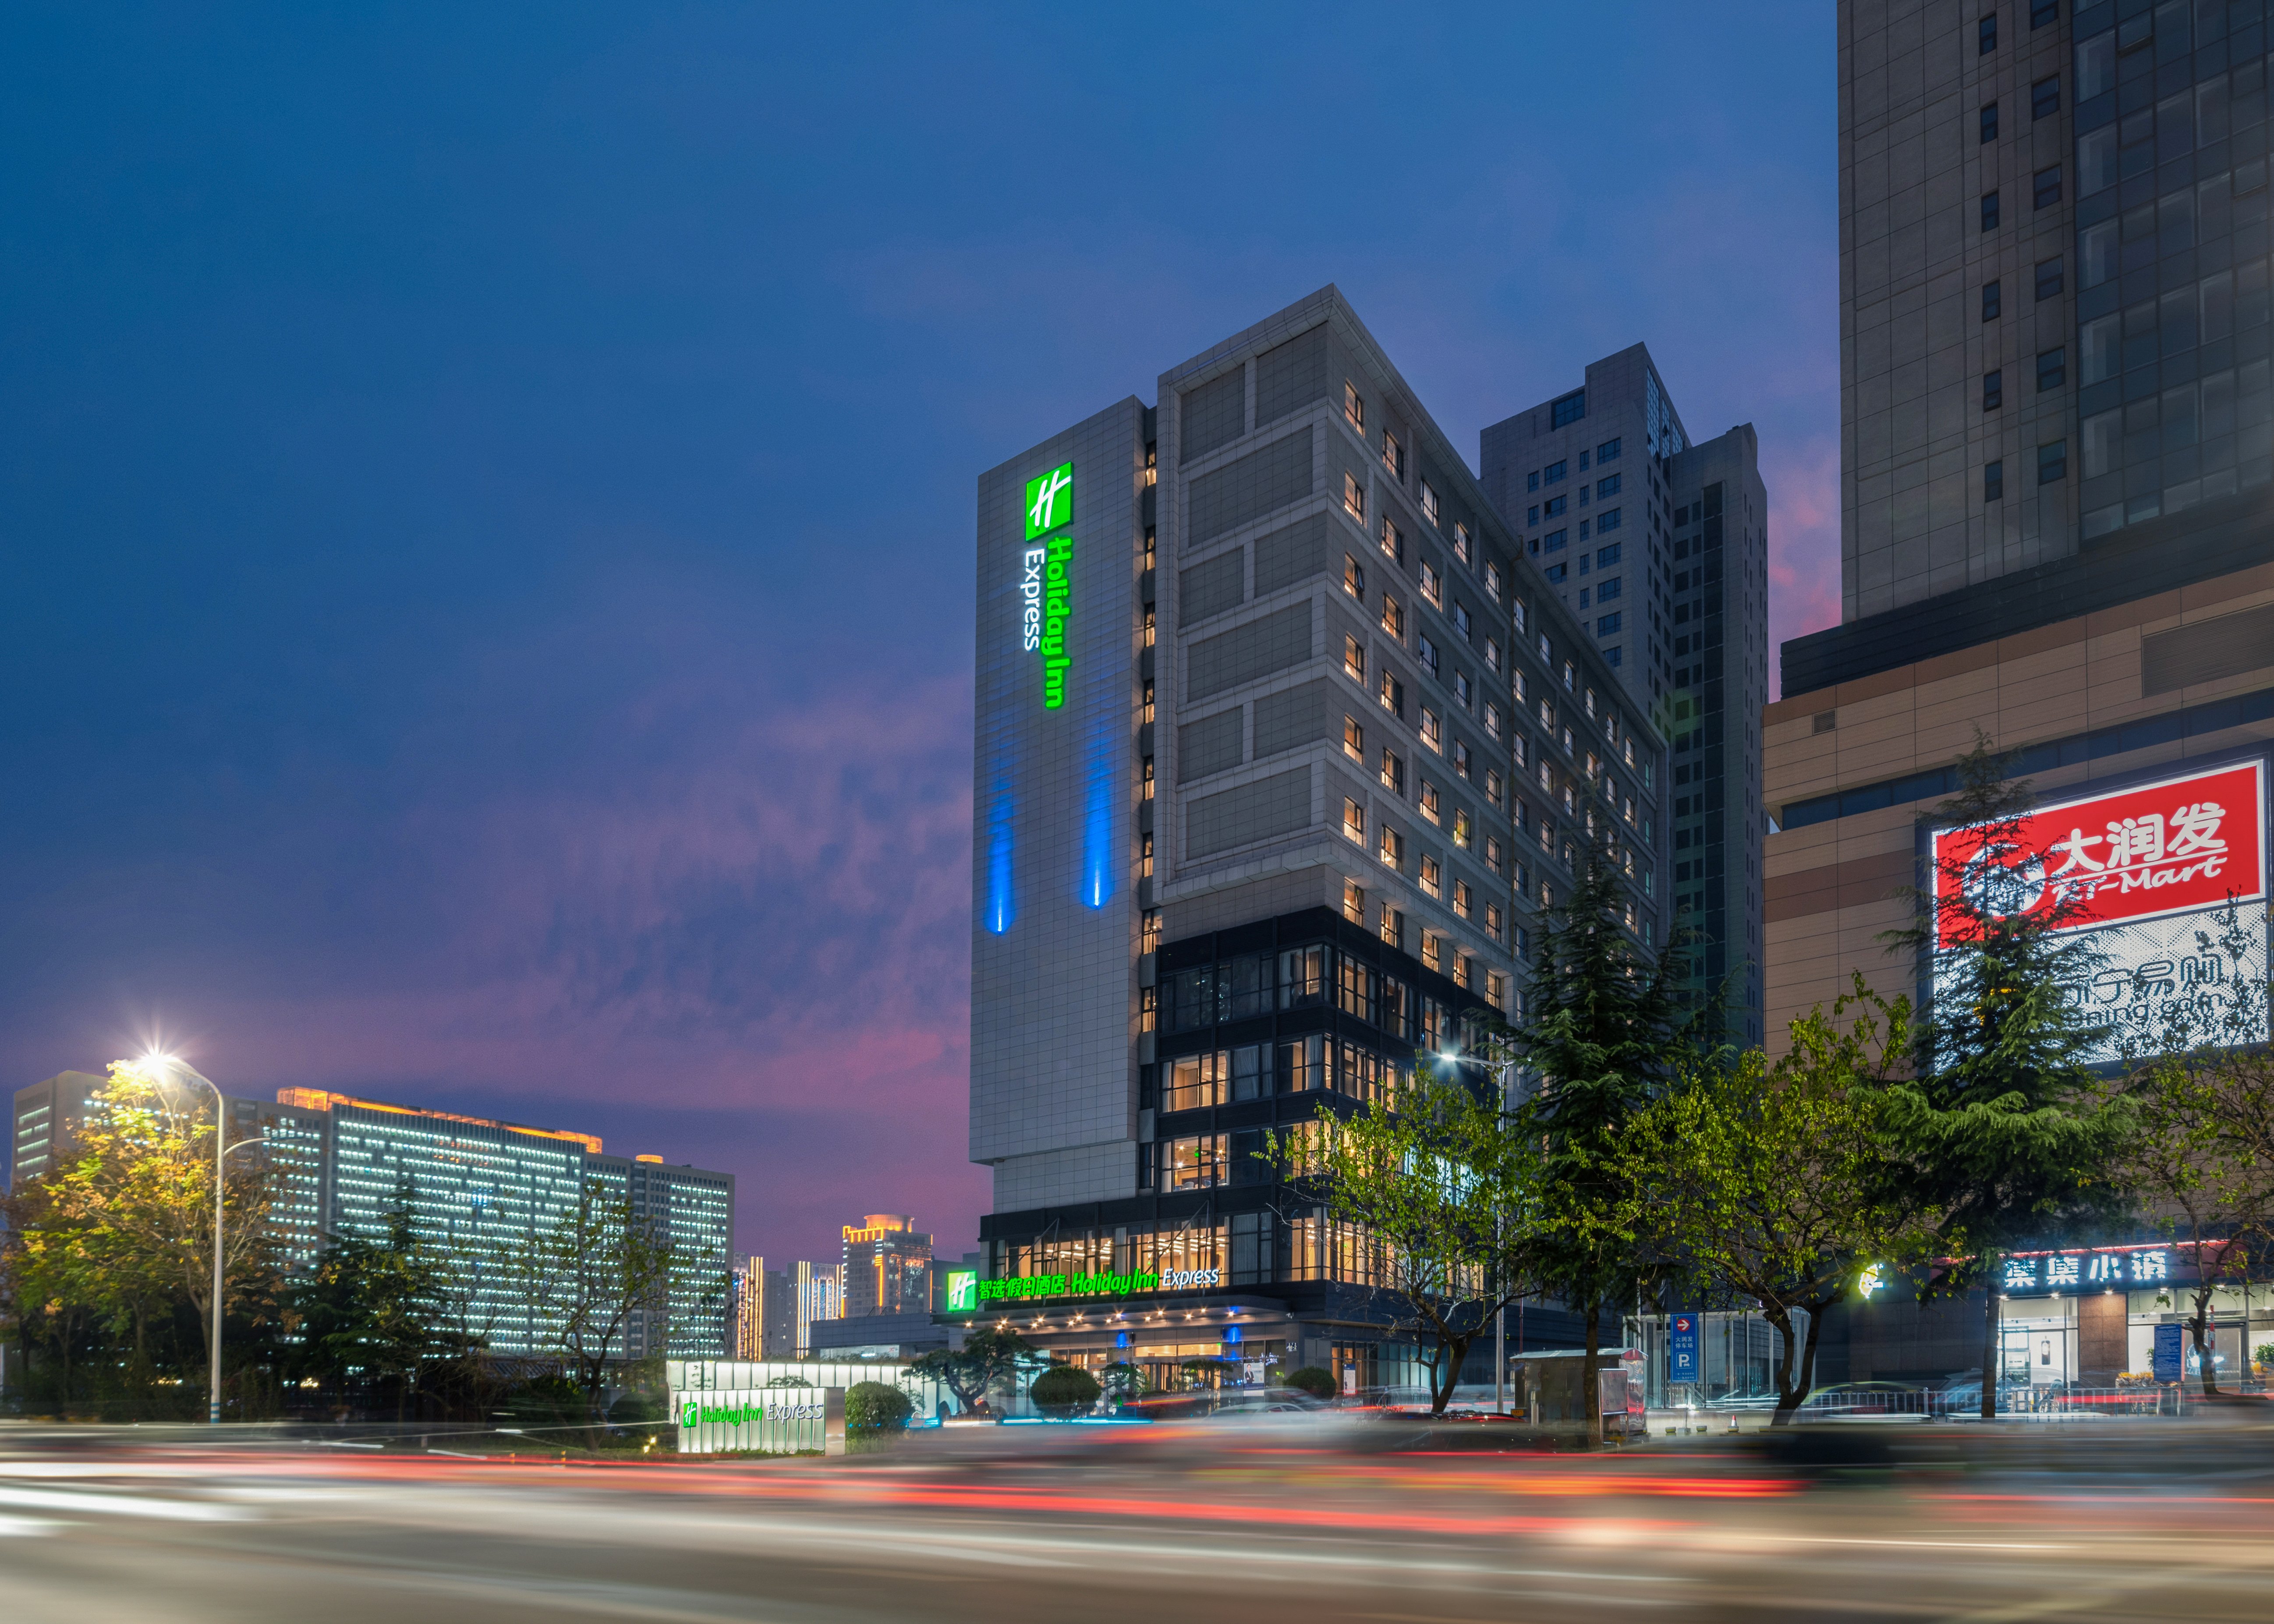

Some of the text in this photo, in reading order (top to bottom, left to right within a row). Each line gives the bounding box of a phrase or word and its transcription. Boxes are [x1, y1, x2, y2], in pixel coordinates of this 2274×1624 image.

[1020, 548, 1045, 651] Express
[1041, 537, 1073, 709] Holiday Inn
[2051, 802, 2226, 873] 大润发
[2052, 856, 2228, 906] RT-Mart
[978, 1273, 1066, 1299] 智选假日酒店
[1071, 1267, 1219, 1295] Holiday Inn Express
[1679, 1354, 1690, 1367] P
[701, 1402, 824, 1427] Holiday Inn Express
